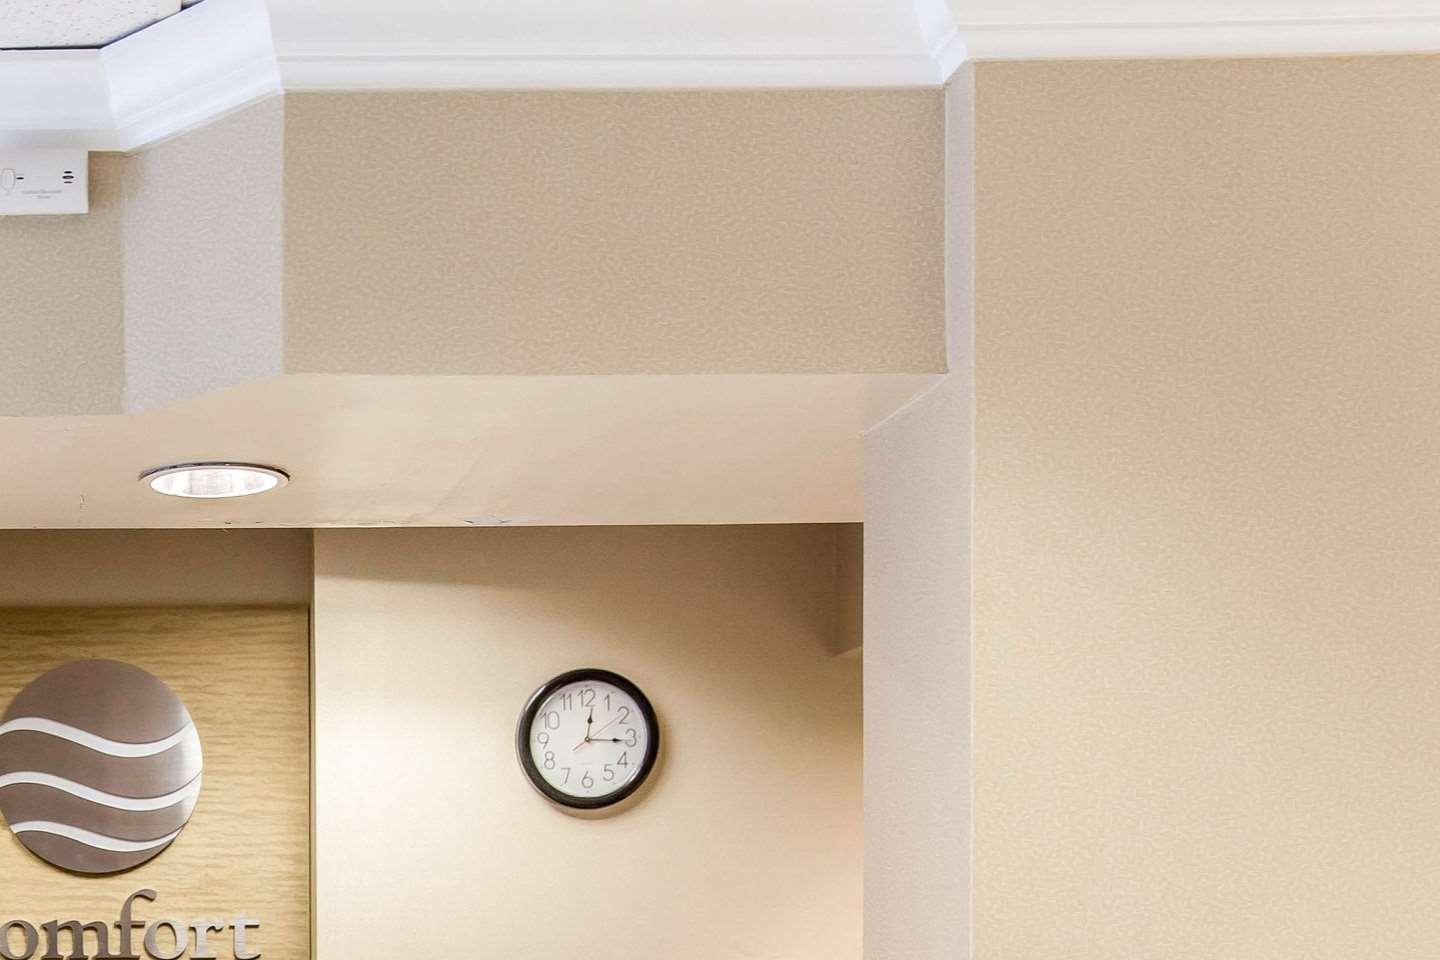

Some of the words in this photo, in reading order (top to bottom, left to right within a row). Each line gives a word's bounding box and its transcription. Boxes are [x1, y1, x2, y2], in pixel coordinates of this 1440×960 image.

[560, 693, 572, 711] 11
[577, 688, 597, 708] 12
[604, 694, 610, 711] 1
[539, 711, 560, 730] 10
[617, 706, 630, 724] 2
[537, 732, 550, 750] 9
[625, 728, 637, 748] 3
[544, 751, 556, 770] 8
[617, 752, 628, 768] 4
[561, 768, 571, 784] 7
[581, 771, 594, 788] 6
[603, 764, 614, 781] 5
